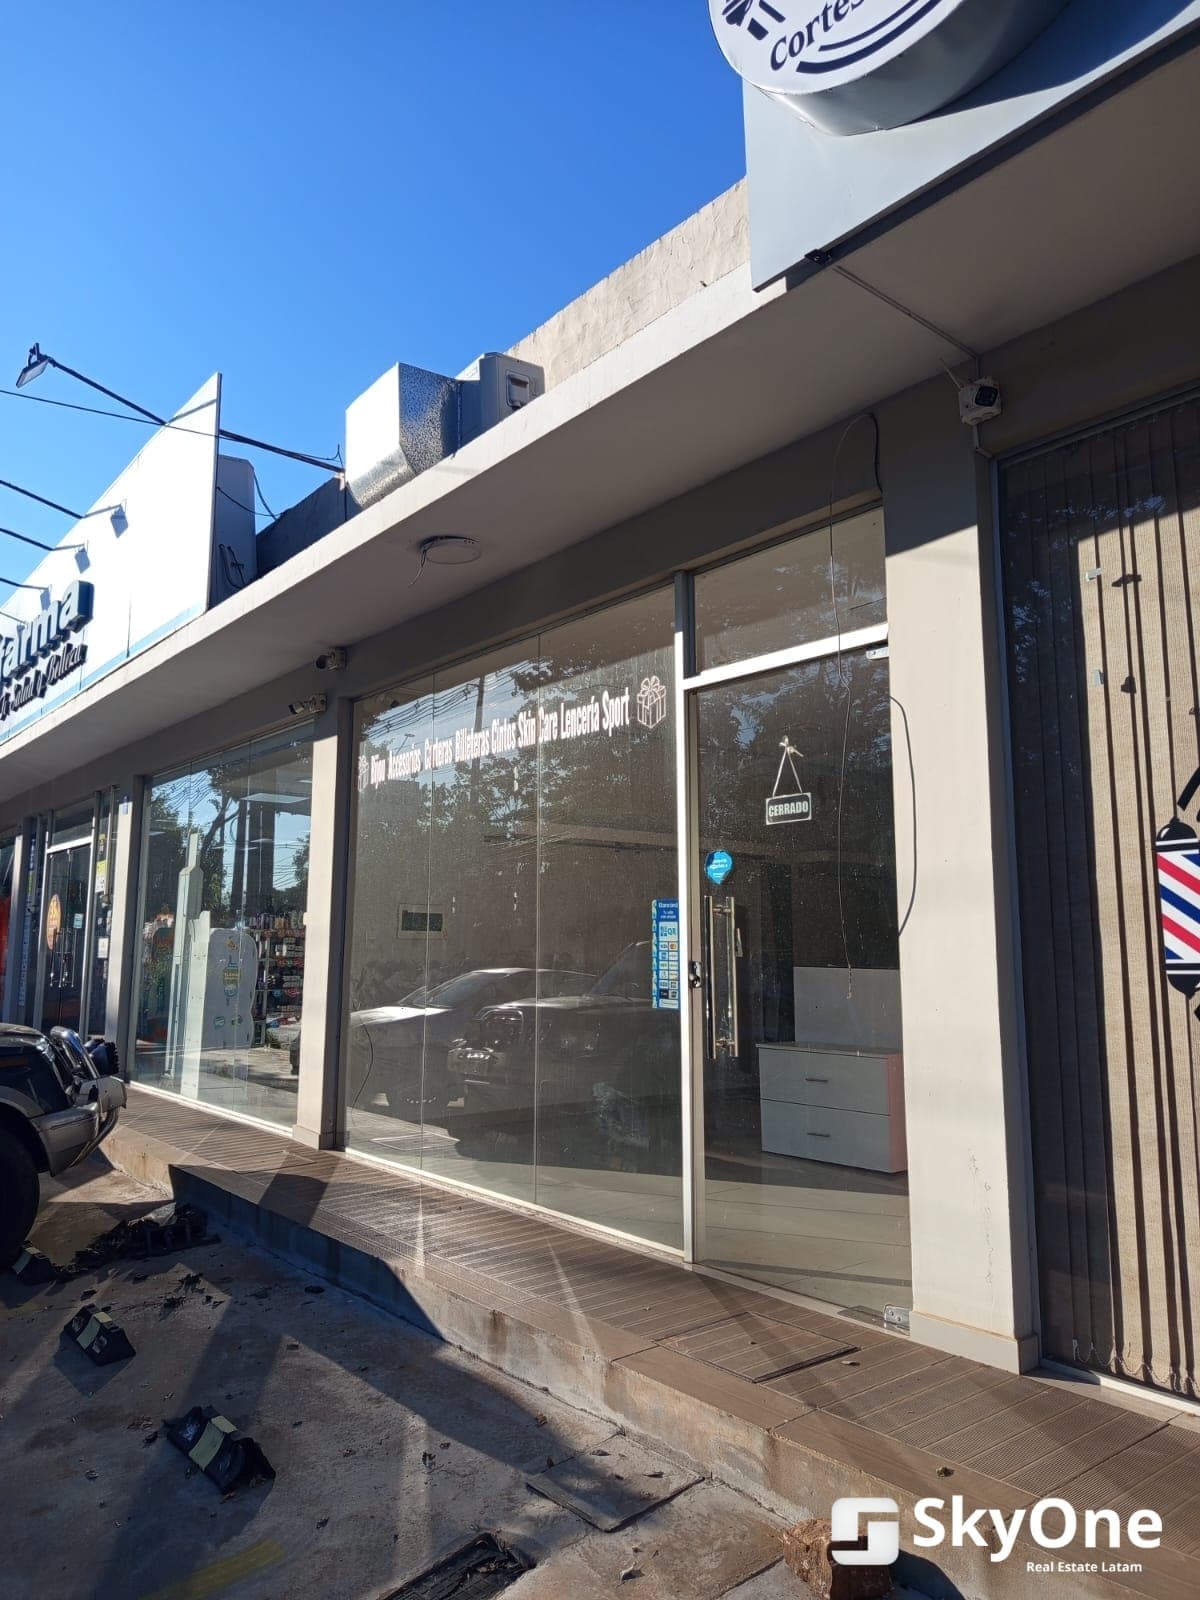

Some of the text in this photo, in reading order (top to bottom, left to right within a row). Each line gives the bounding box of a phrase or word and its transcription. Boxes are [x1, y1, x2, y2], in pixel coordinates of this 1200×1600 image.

[0, 580, 95, 692] arma
[46, 643, 88, 686] Belleza
[425, 737, 452, 770] Carteras
[455, 728, 489, 762] Billeteras
[492, 718, 517, 754] Cintos
[518, 710, 536, 748] Skin
[538, 706, 558, 743] Care
[560, 695, 600, 739] Lencería
[602, 687, 630, 737] Sport
[768, 800, 809, 817] CERRADO
